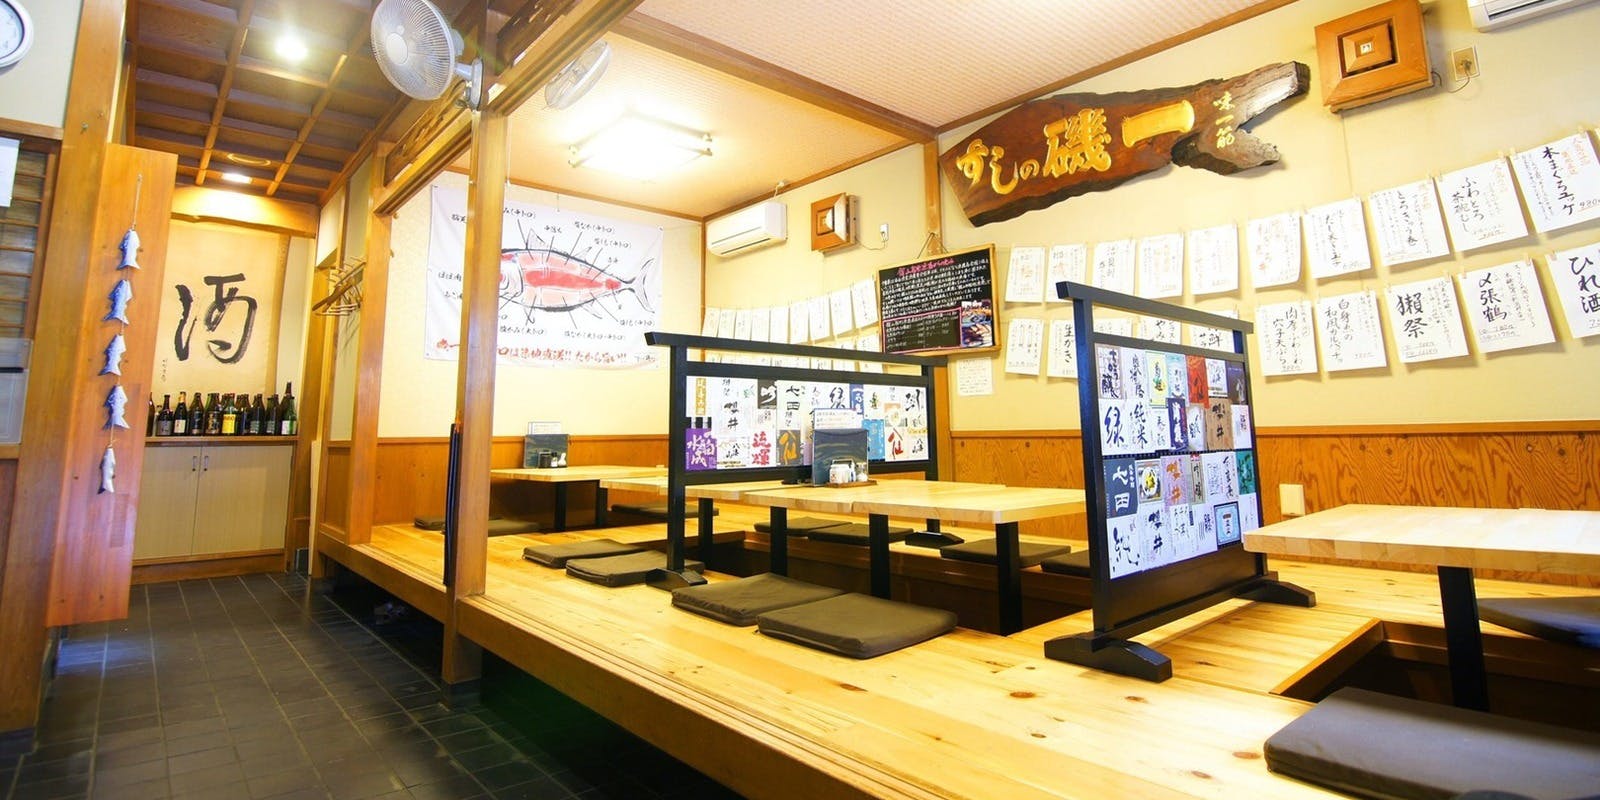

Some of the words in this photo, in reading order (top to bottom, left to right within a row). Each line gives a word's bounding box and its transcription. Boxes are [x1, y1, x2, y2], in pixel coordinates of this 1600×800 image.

[1213, 91, 1236, 149] 味一筋
[1479, 272, 1507, 324] 〆張鶴
[1569, 256, 1600, 314] ひれ酒
[174, 273, 258, 365] 酒
[1397, 292, 1428, 339] 獺祭
[1112, 465, 1130, 512] 七田
